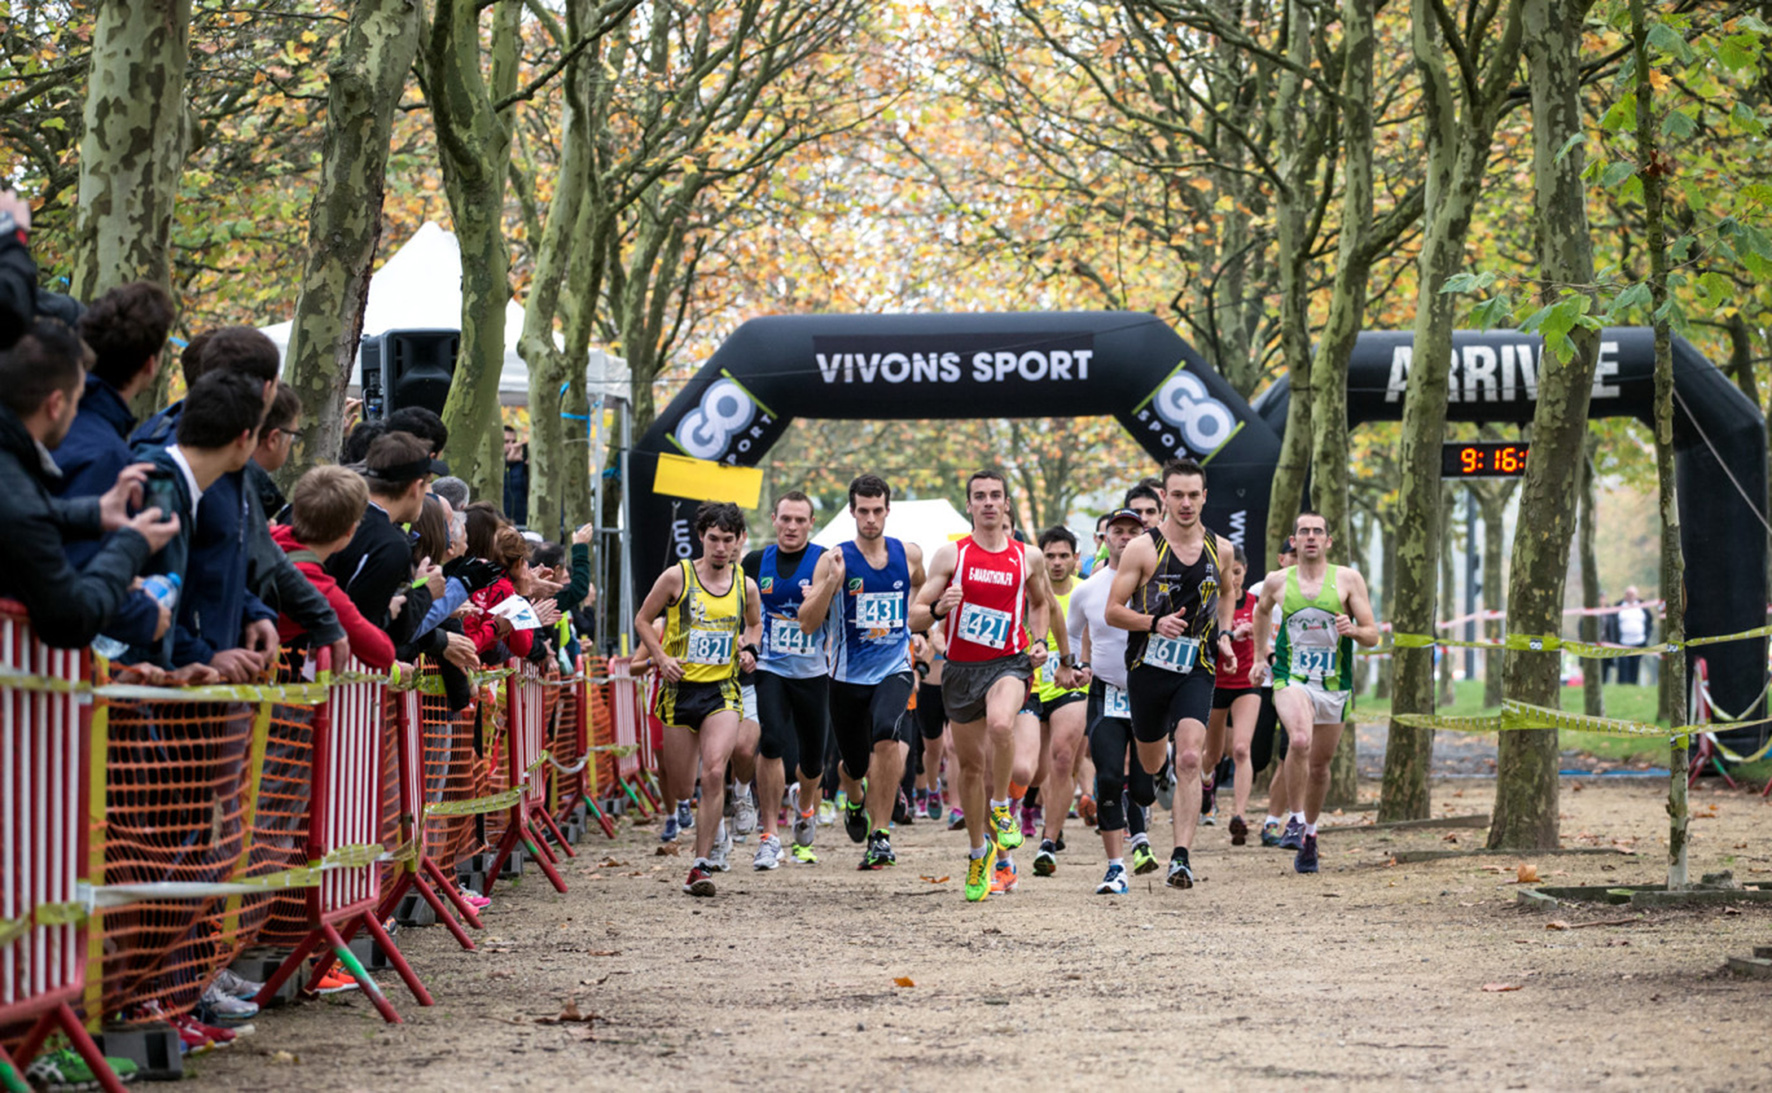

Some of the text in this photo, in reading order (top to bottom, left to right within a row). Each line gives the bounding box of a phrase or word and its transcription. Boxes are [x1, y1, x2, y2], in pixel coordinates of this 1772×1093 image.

[816, 350, 1094, 383] VIVONS SPORT
[677, 380, 755, 460] GO
[1155, 371, 1235, 453] GO
[726, 413, 773, 465] PORT
[968, 566, 1014, 587] E-MARATHON.FR
[867, 599, 900, 621] 431
[779, 626, 814, 648] 441
[968, 614, 1007, 641] 421
[697, 637, 731, 657] 821
[1156, 640, 1195, 666] 611
[1300, 651, 1334, 671] 321
